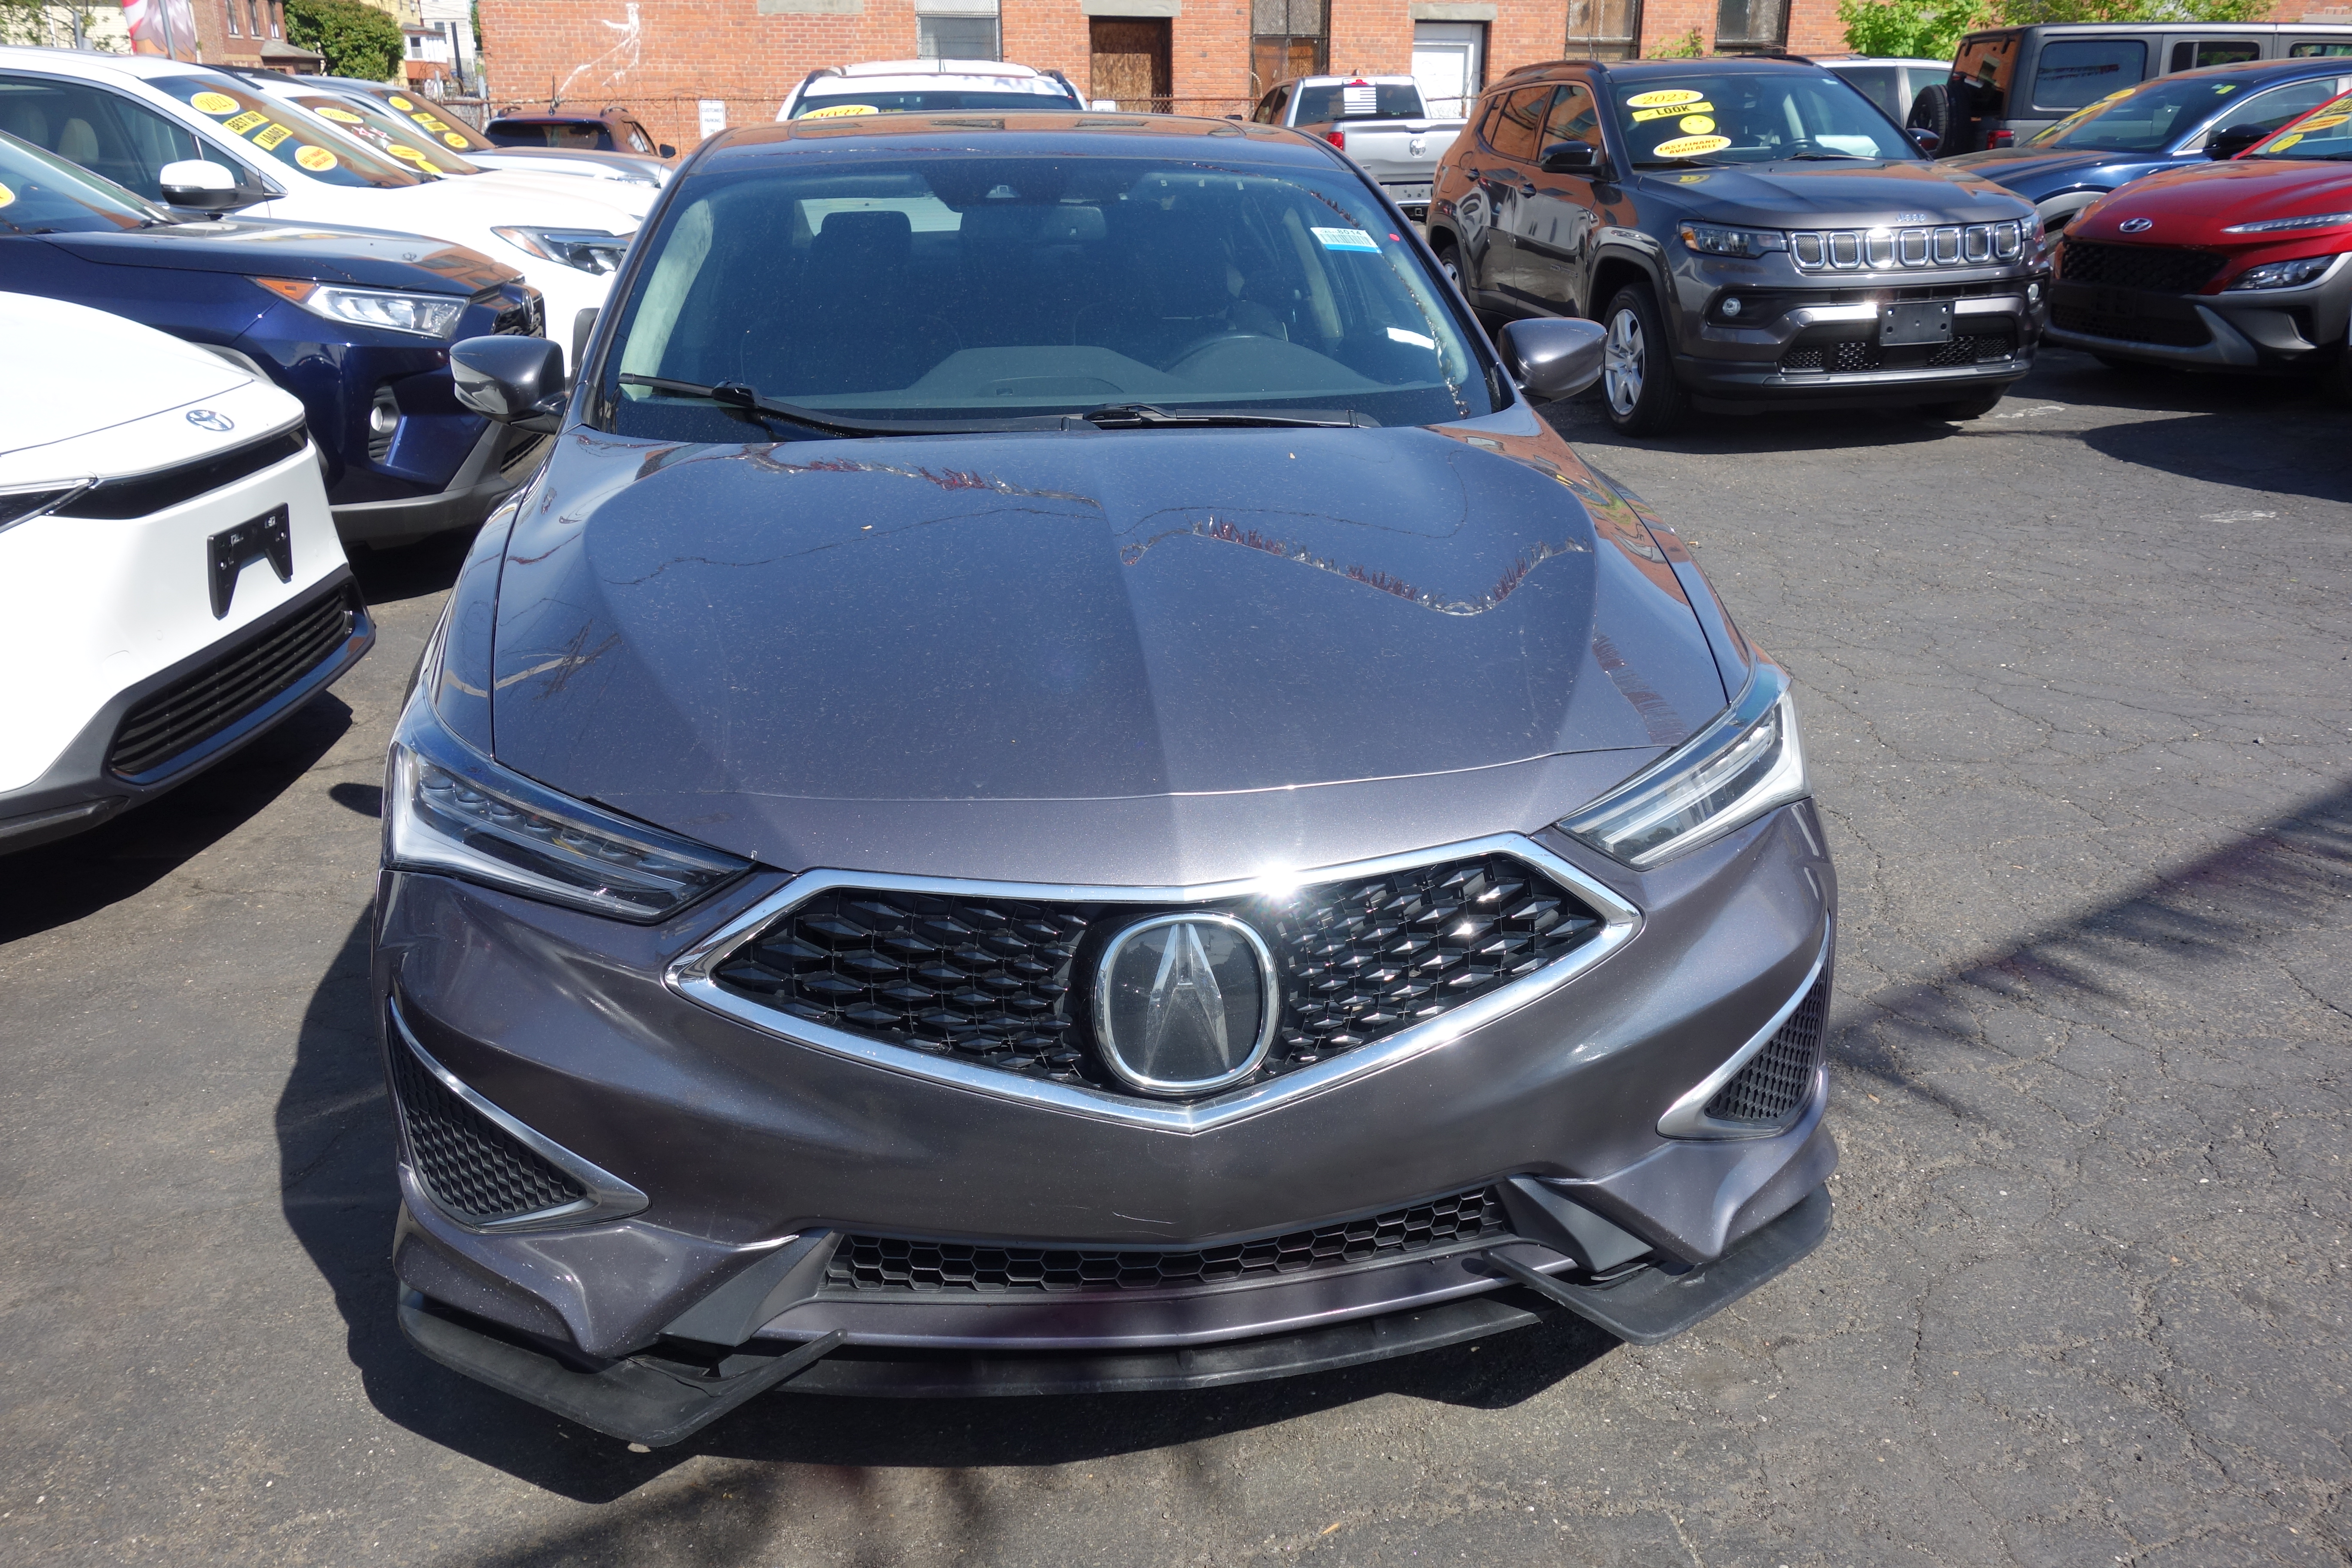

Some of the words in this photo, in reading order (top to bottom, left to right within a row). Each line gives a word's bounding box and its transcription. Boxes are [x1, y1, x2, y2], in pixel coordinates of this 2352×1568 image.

[200, 95, 233, 111] 2021
[1642, 92, 1689, 104] 2023
[1656, 105, 1692, 115] LOOK
[227, 116, 251, 131] BEST
[247, 111, 264, 122] BUY
[260, 126, 288, 145] LOADED
[1685, 138, 1723, 147] FINANCE
[1669, 144, 1717, 154] AVAILABLE
[300, 156, 312, 165] EASY
[309, 149, 325, 159] FINANCE
[312, 155, 332, 168] AVAILABLE
[1896, 213, 1926, 223] Jeep
